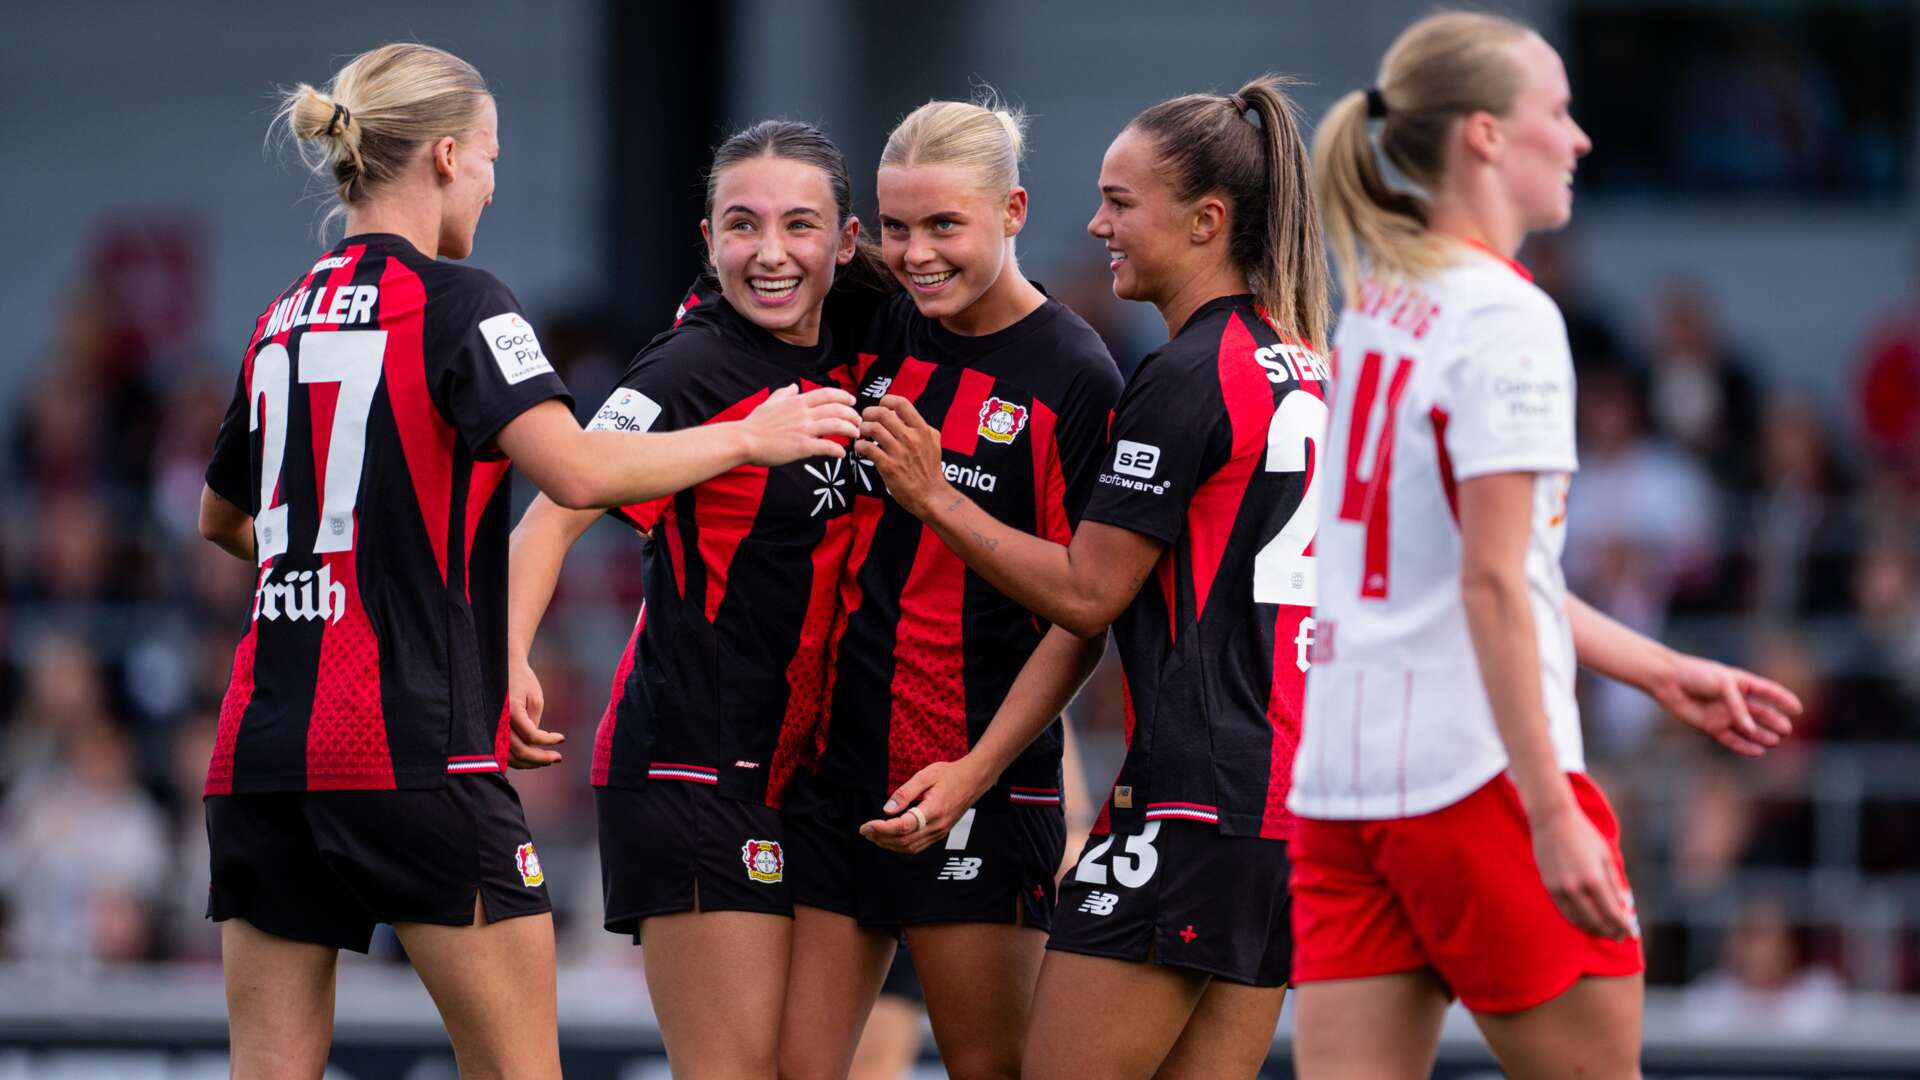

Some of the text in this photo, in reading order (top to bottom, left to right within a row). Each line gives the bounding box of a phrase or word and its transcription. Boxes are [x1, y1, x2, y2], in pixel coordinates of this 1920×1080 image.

[259, 285, 379, 341] MÜLLER
[249, 330, 389, 569] 27
[1118, 451, 1154, 471] s2
[1330, 347, 1415, 601] 4
[1074, 819, 1162, 889] 23
